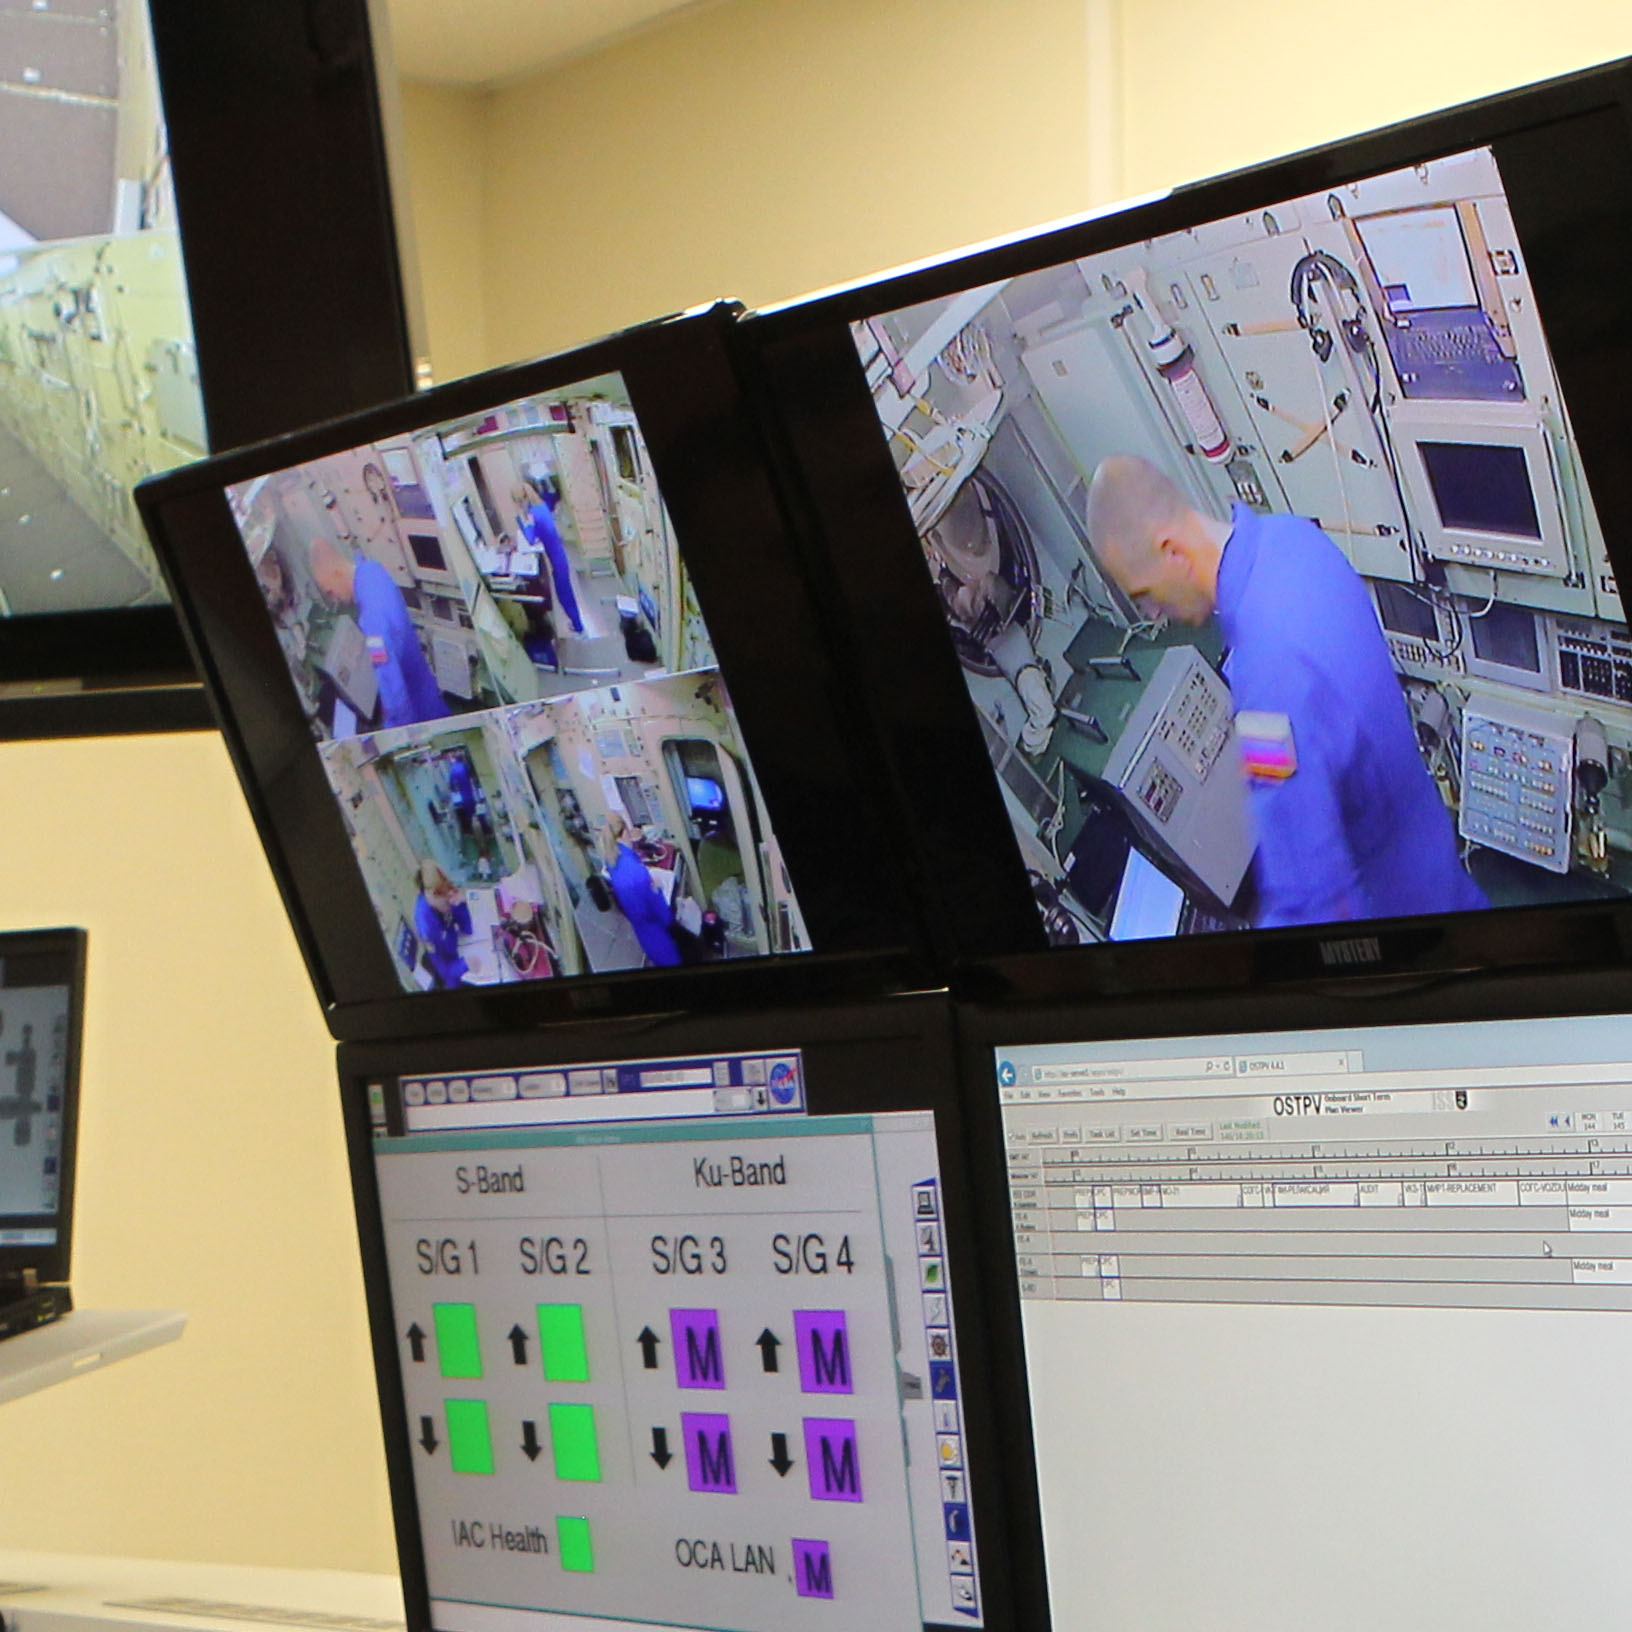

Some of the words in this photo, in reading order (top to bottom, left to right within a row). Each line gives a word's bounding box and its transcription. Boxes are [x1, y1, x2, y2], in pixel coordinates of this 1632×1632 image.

[1273, 1096, 1322, 1116] OSTPV
[456, 1164, 525, 1195] S-Band
[694, 1155, 786, 1188] Ku-Band
[418, 1239, 463, 1276] S/G
[468, 1239, 480, 1273] 1
[519, 1239, 566, 1276] S/G
[572, 1238, 591, 1276] 2
[652, 1238, 704, 1275] S/G
[710, 1238, 728, 1274] 3
[773, 1237, 828, 1275] S/G
[835, 1238, 855, 1273] 4
[686, 1327, 720, 1384] M
[812, 1328, 848, 1388] M
[698, 1431, 732, 1487] M
[821, 1437, 857, 1496] M
[452, 1521, 485, 1551] IAC
[489, 1524, 549, 1556] Health
[675, 1540, 724, 1571] OCA
[731, 1544, 776, 1576] LAN
[804, 1557, 830, 1594] M
